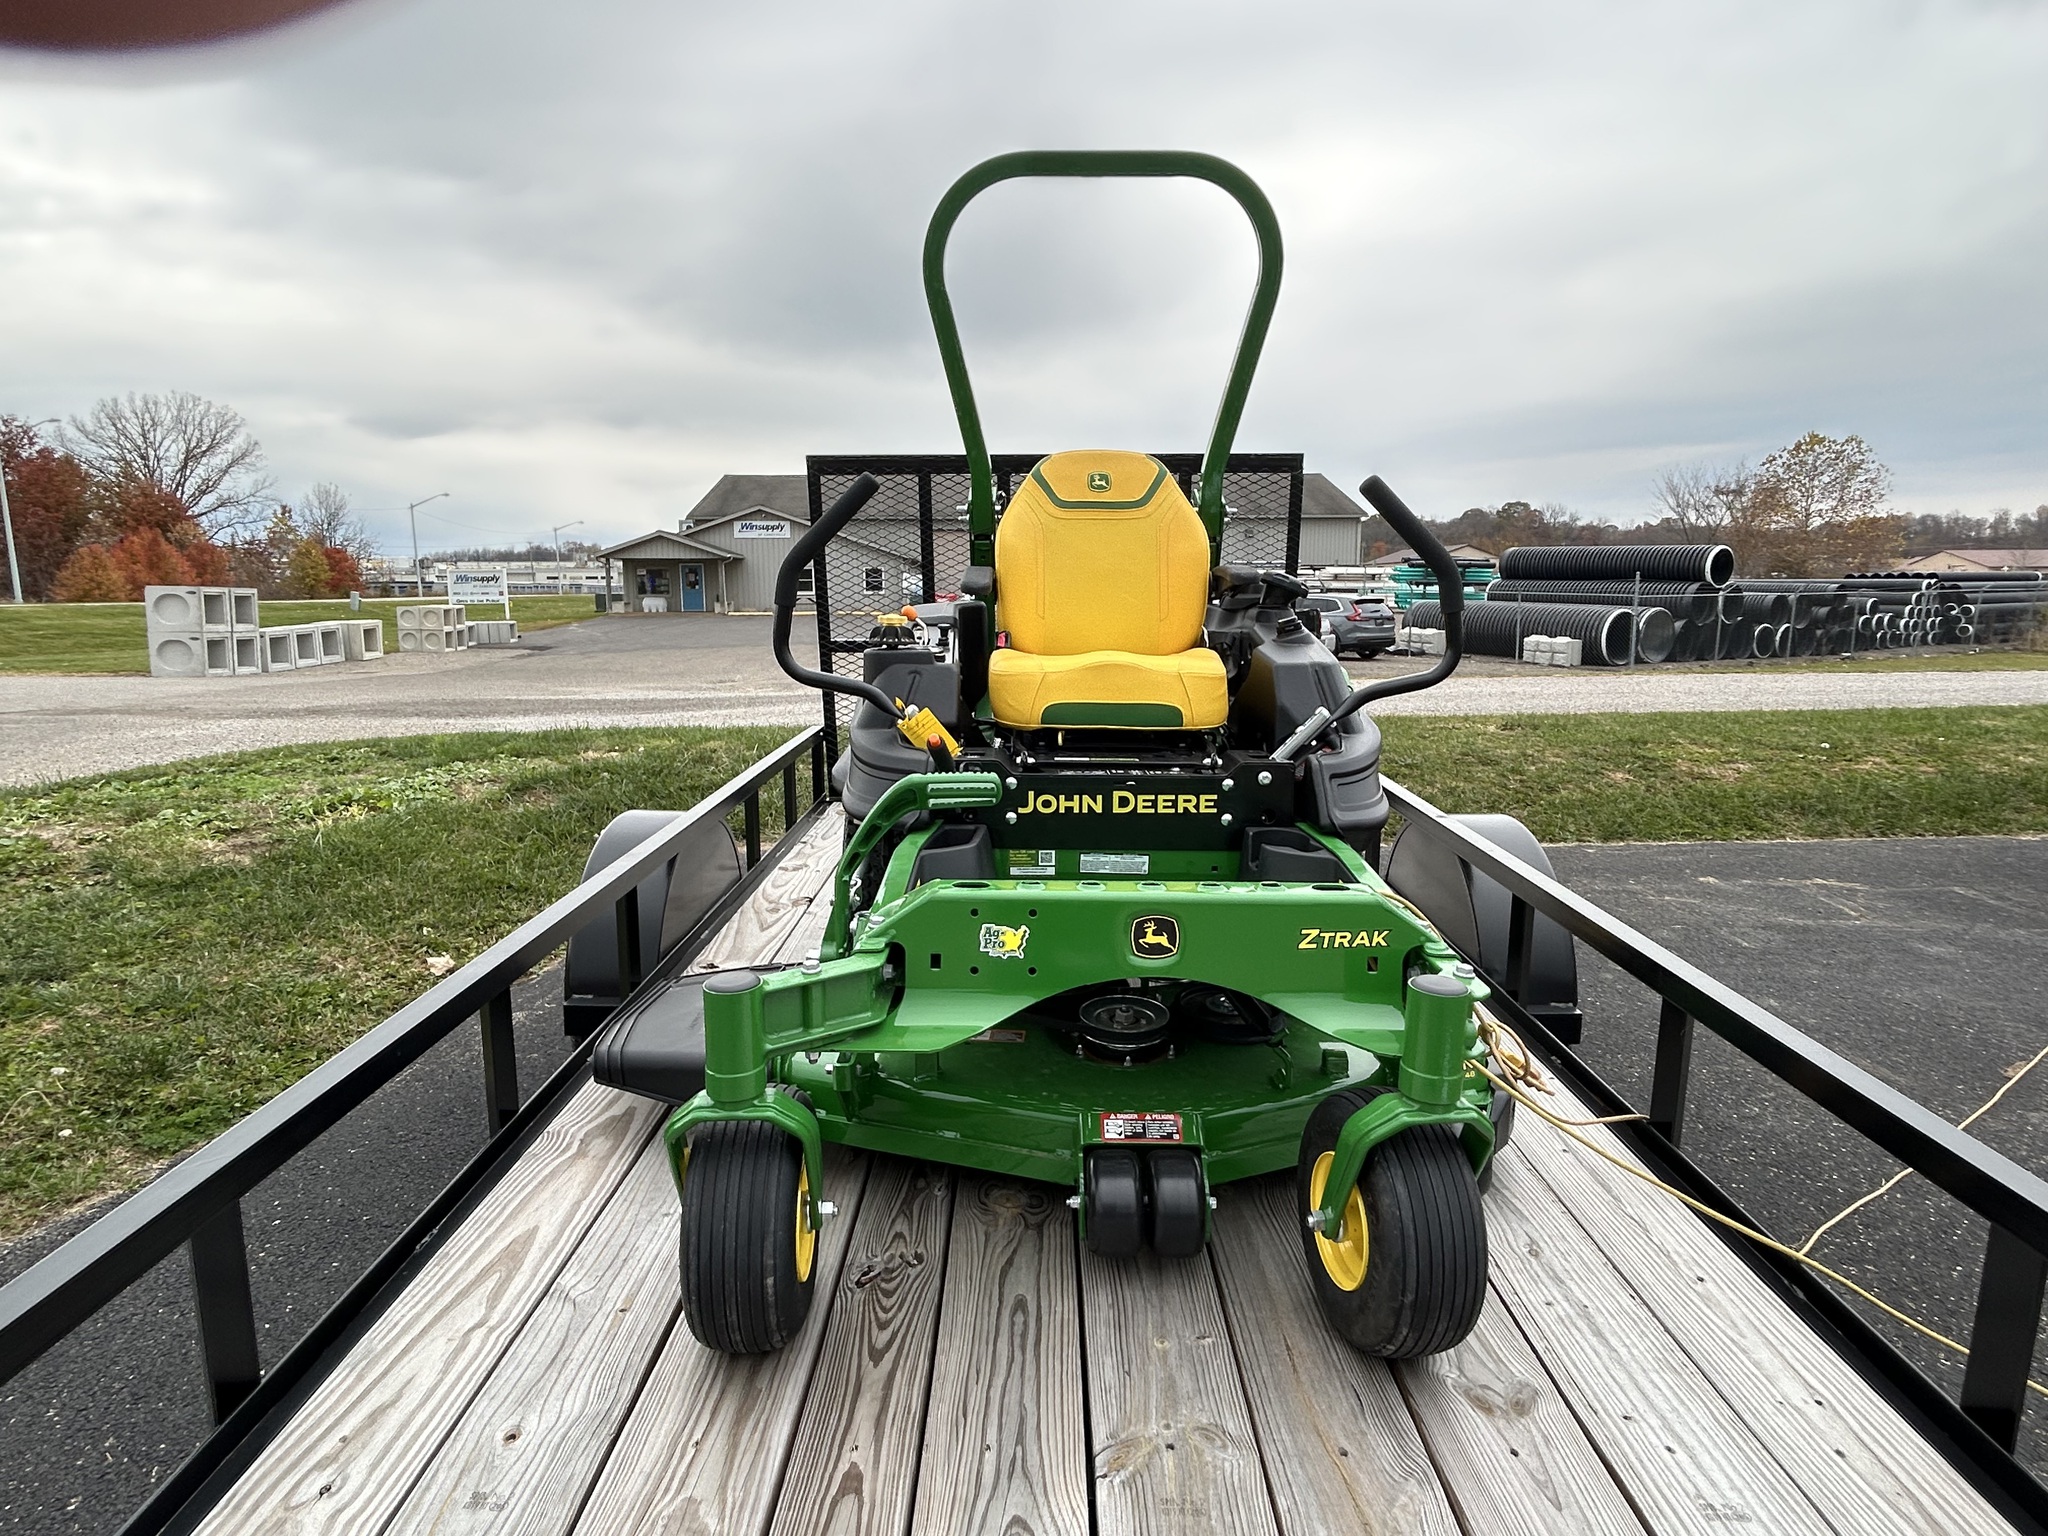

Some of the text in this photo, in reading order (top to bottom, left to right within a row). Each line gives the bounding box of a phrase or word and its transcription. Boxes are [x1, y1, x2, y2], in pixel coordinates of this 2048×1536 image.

[740, 522, 786, 533] Winsupply
[455, 574, 501, 584] Winsupply
[1017, 790, 1218, 814] JOHN DEERE
[984, 937, 1005, 949] Pro
[1297, 928, 1390, 950] ZTRAK
